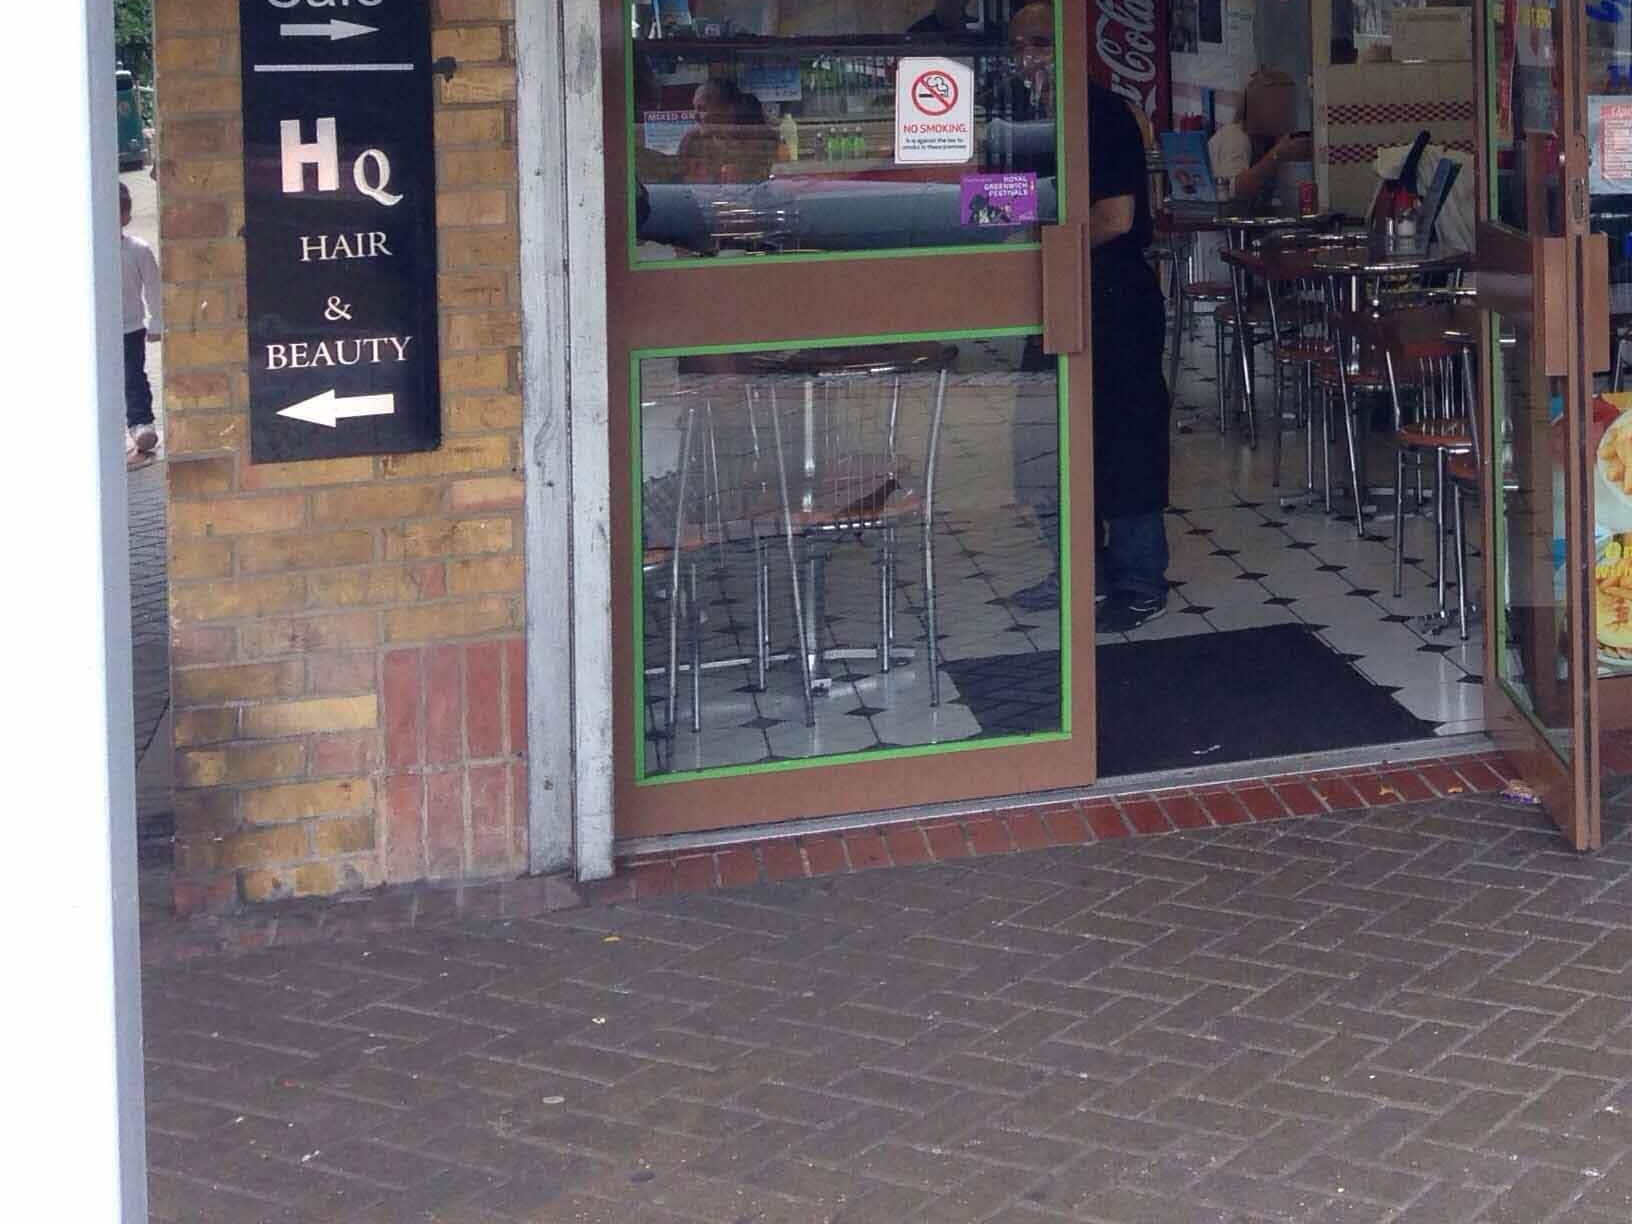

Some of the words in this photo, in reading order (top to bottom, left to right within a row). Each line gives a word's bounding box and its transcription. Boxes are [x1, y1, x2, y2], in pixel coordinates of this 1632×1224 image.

[903, 123, 918, 134] NO
[300, 231, 392, 262] HAIR
[324, 296, 352, 321] &
[266, 336, 414, 370] BEAUTY
